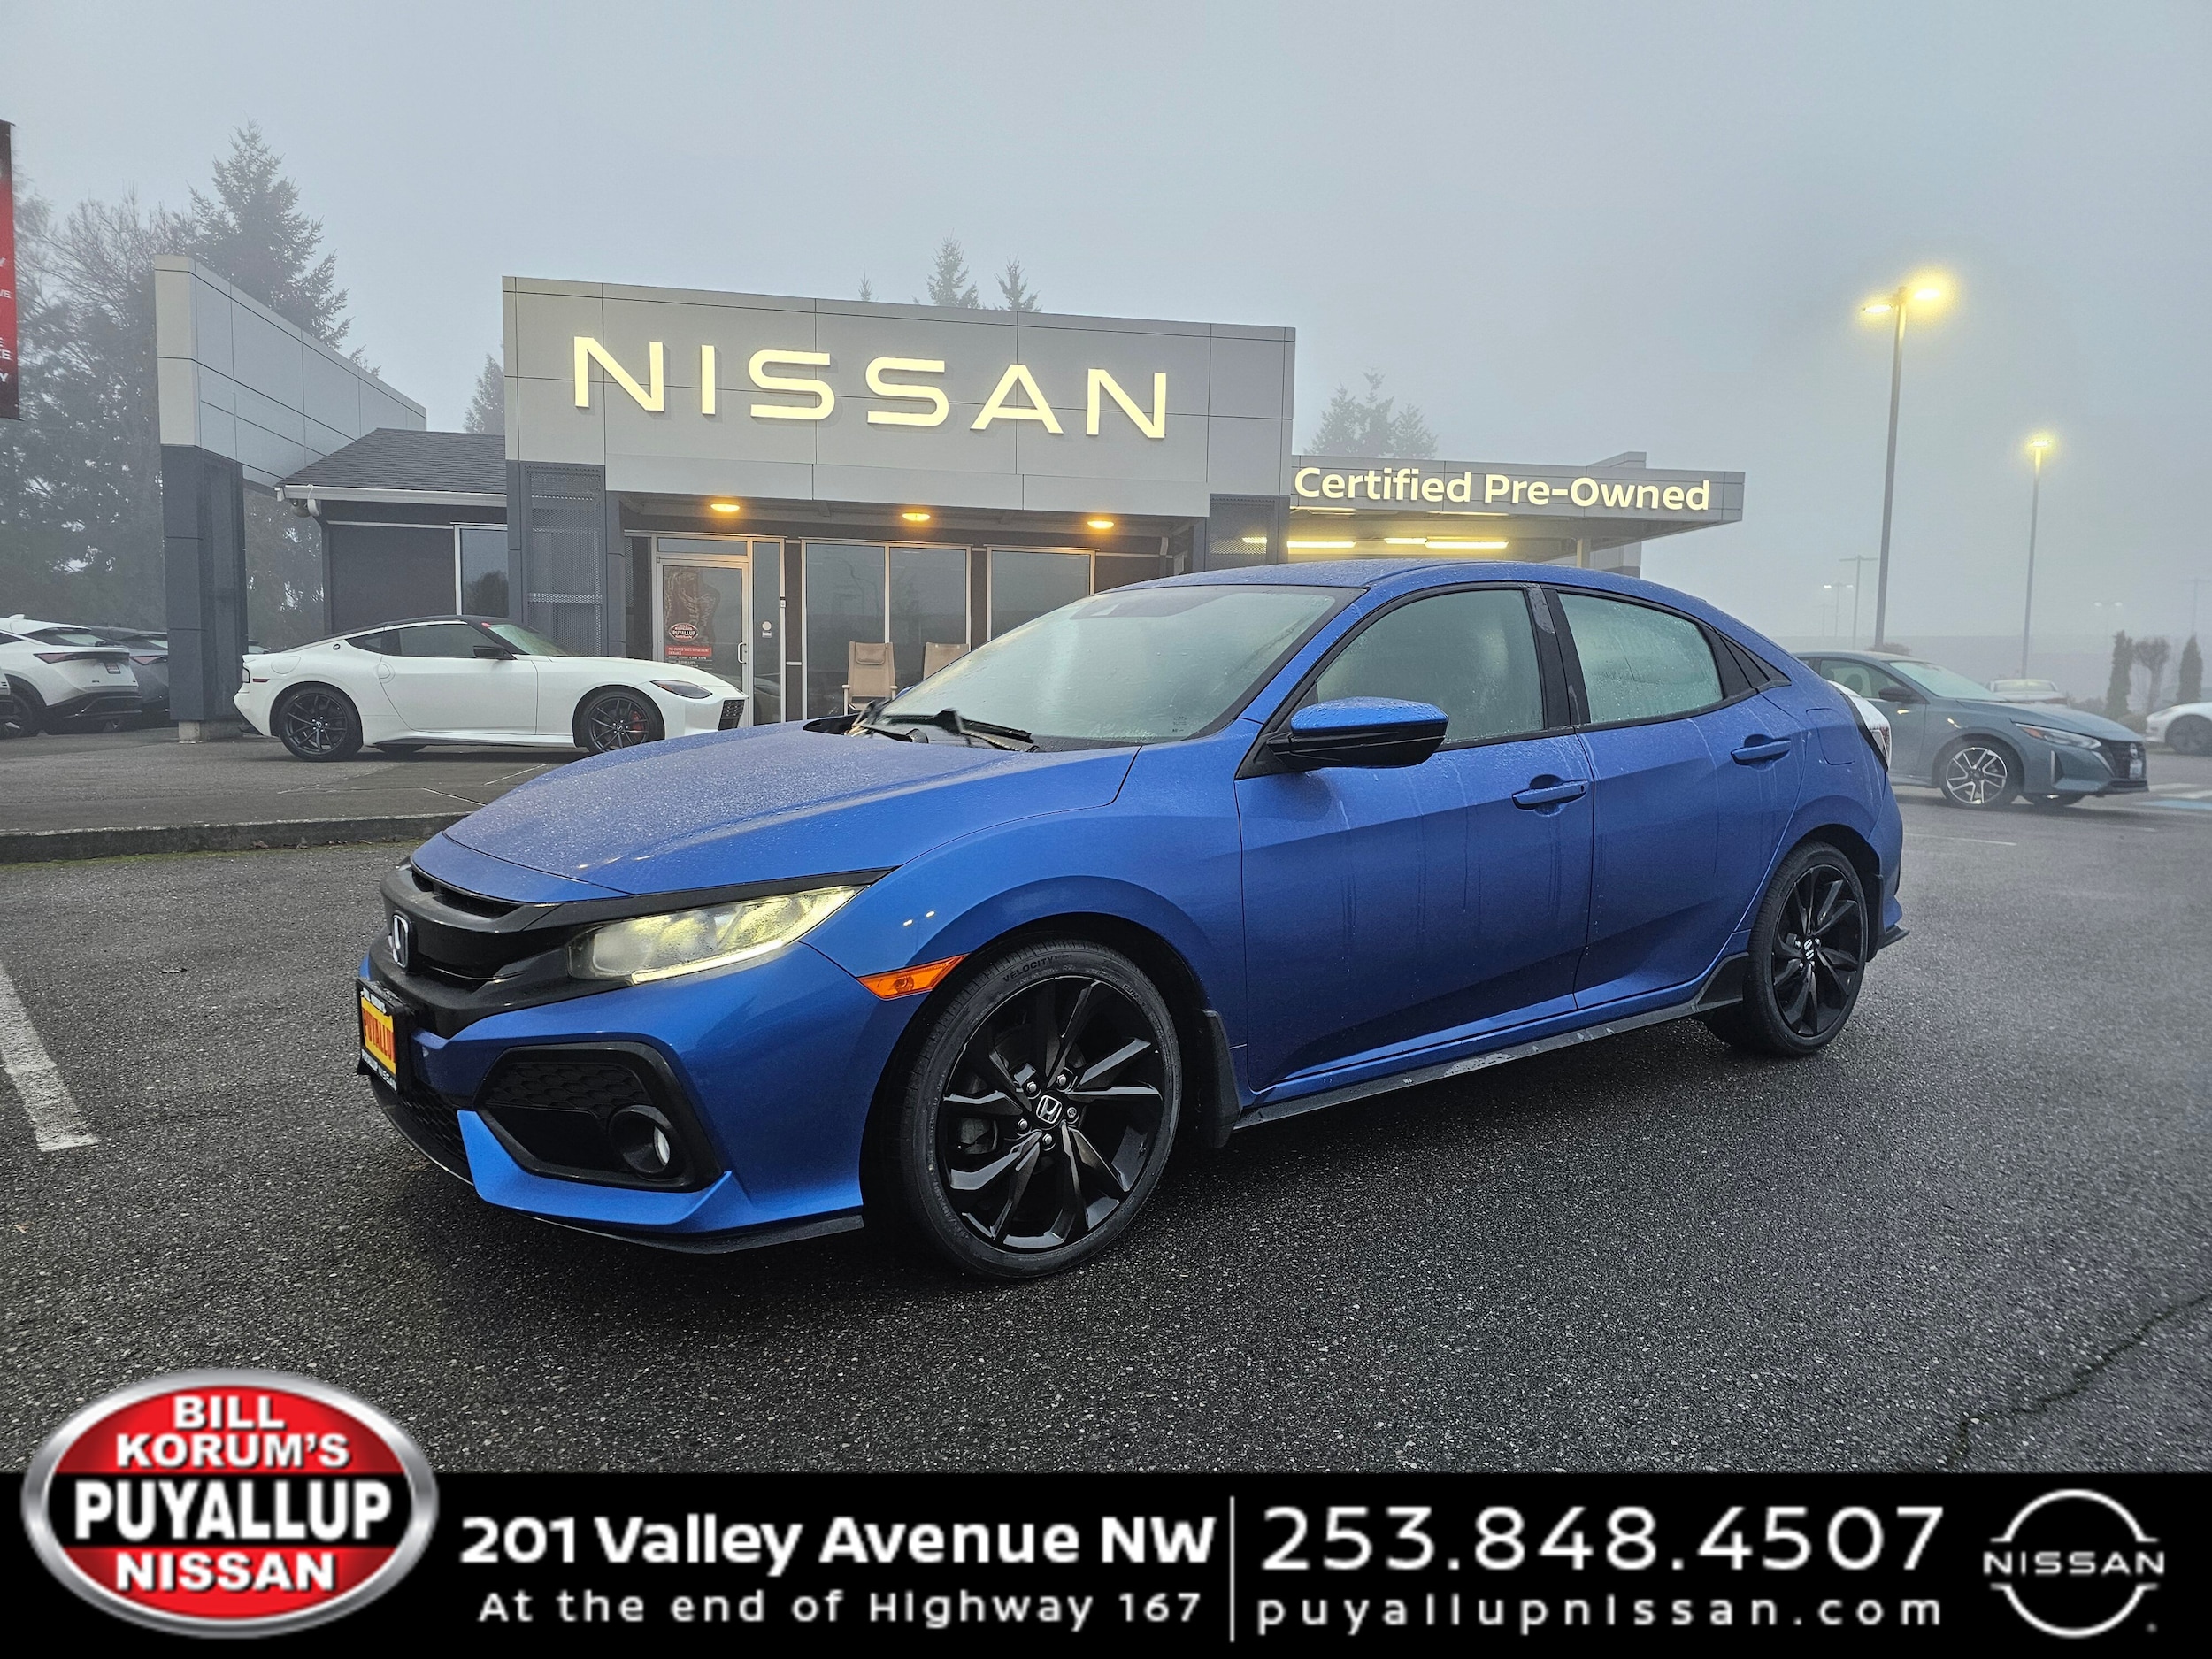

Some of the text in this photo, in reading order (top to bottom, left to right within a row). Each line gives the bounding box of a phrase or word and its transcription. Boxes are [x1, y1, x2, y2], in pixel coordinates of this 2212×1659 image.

[574, 336, 1166, 438] NISSAN
[1294, 467, 1710, 511] Certified Pre-Owned
[1002, 956, 1053, 982] VELOCITY
